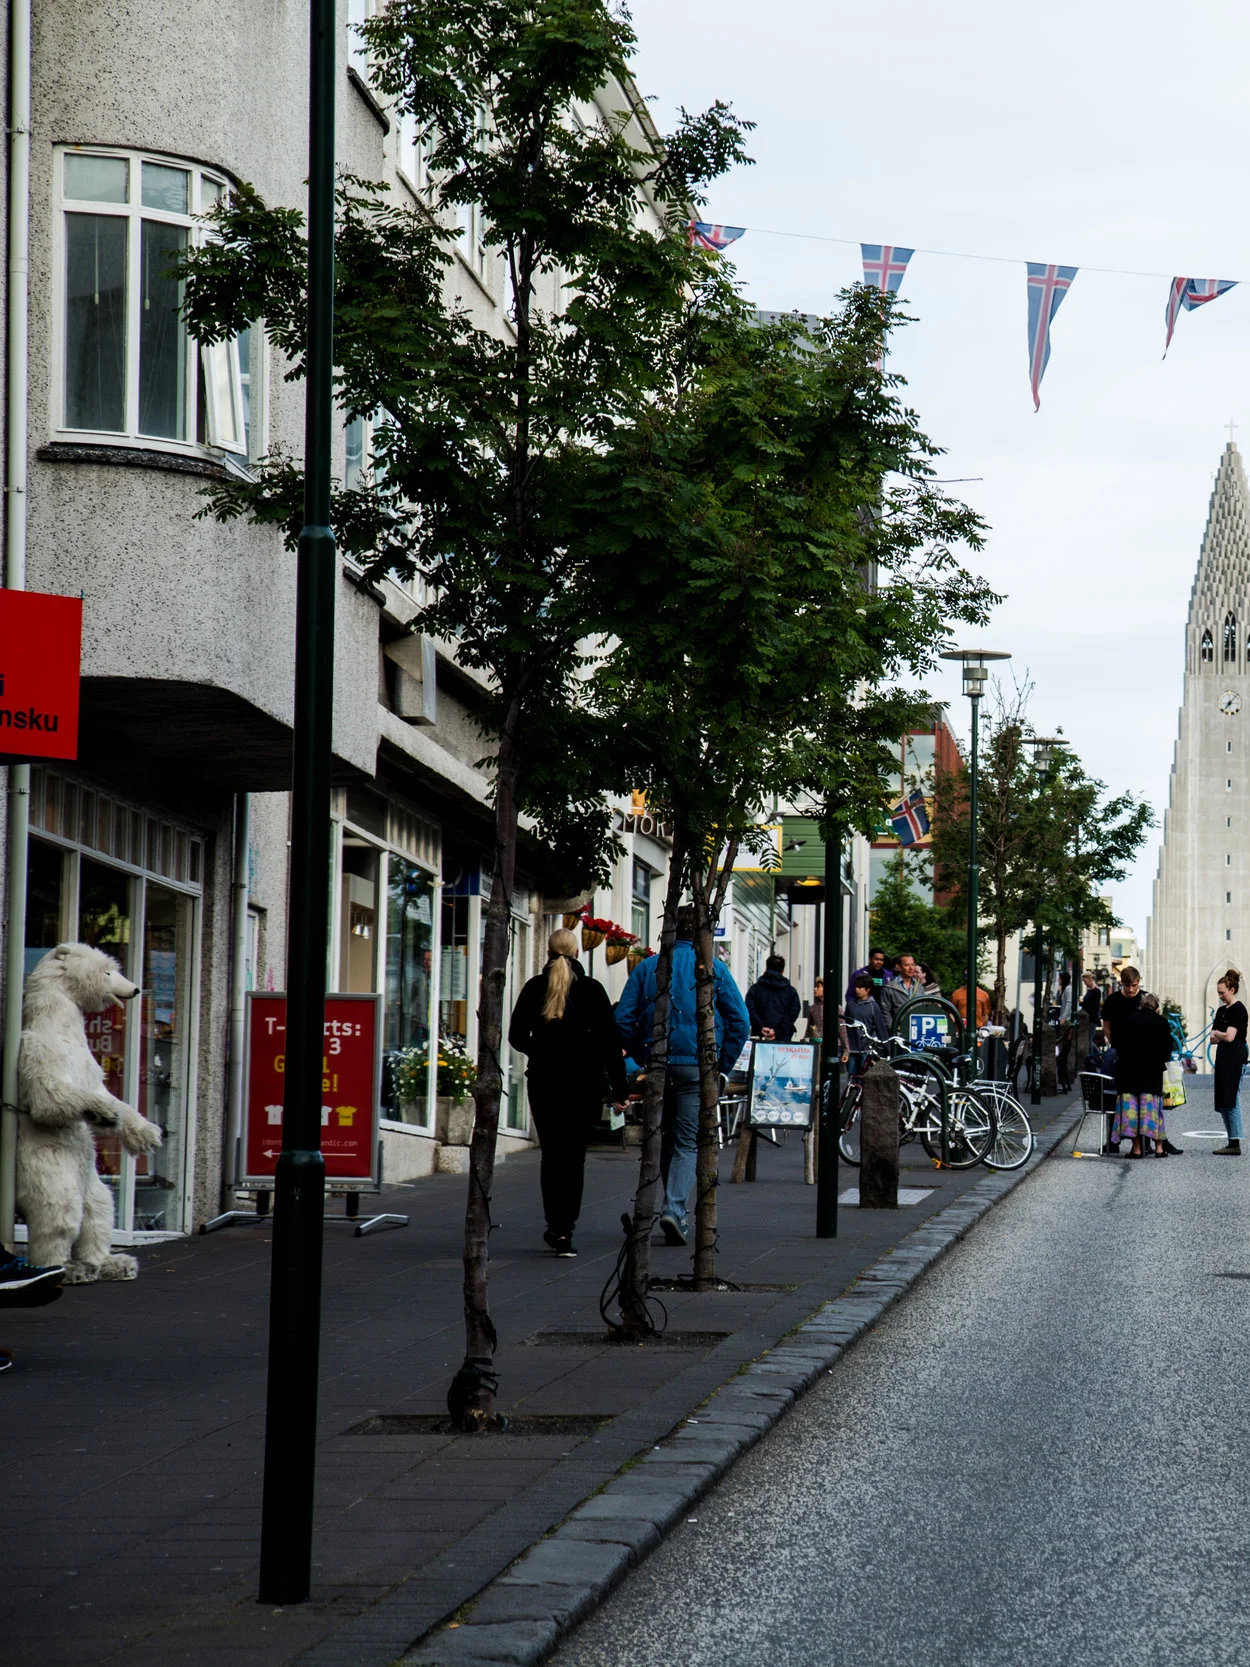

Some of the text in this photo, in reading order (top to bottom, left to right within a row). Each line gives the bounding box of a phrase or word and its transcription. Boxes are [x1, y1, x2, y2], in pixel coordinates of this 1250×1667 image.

[0, 707, 59, 733] nsku
[264, 1016, 362, 1037] T-rts:
[921, 1017, 936, 1035] P
[328, 1036, 342, 1055] 3
